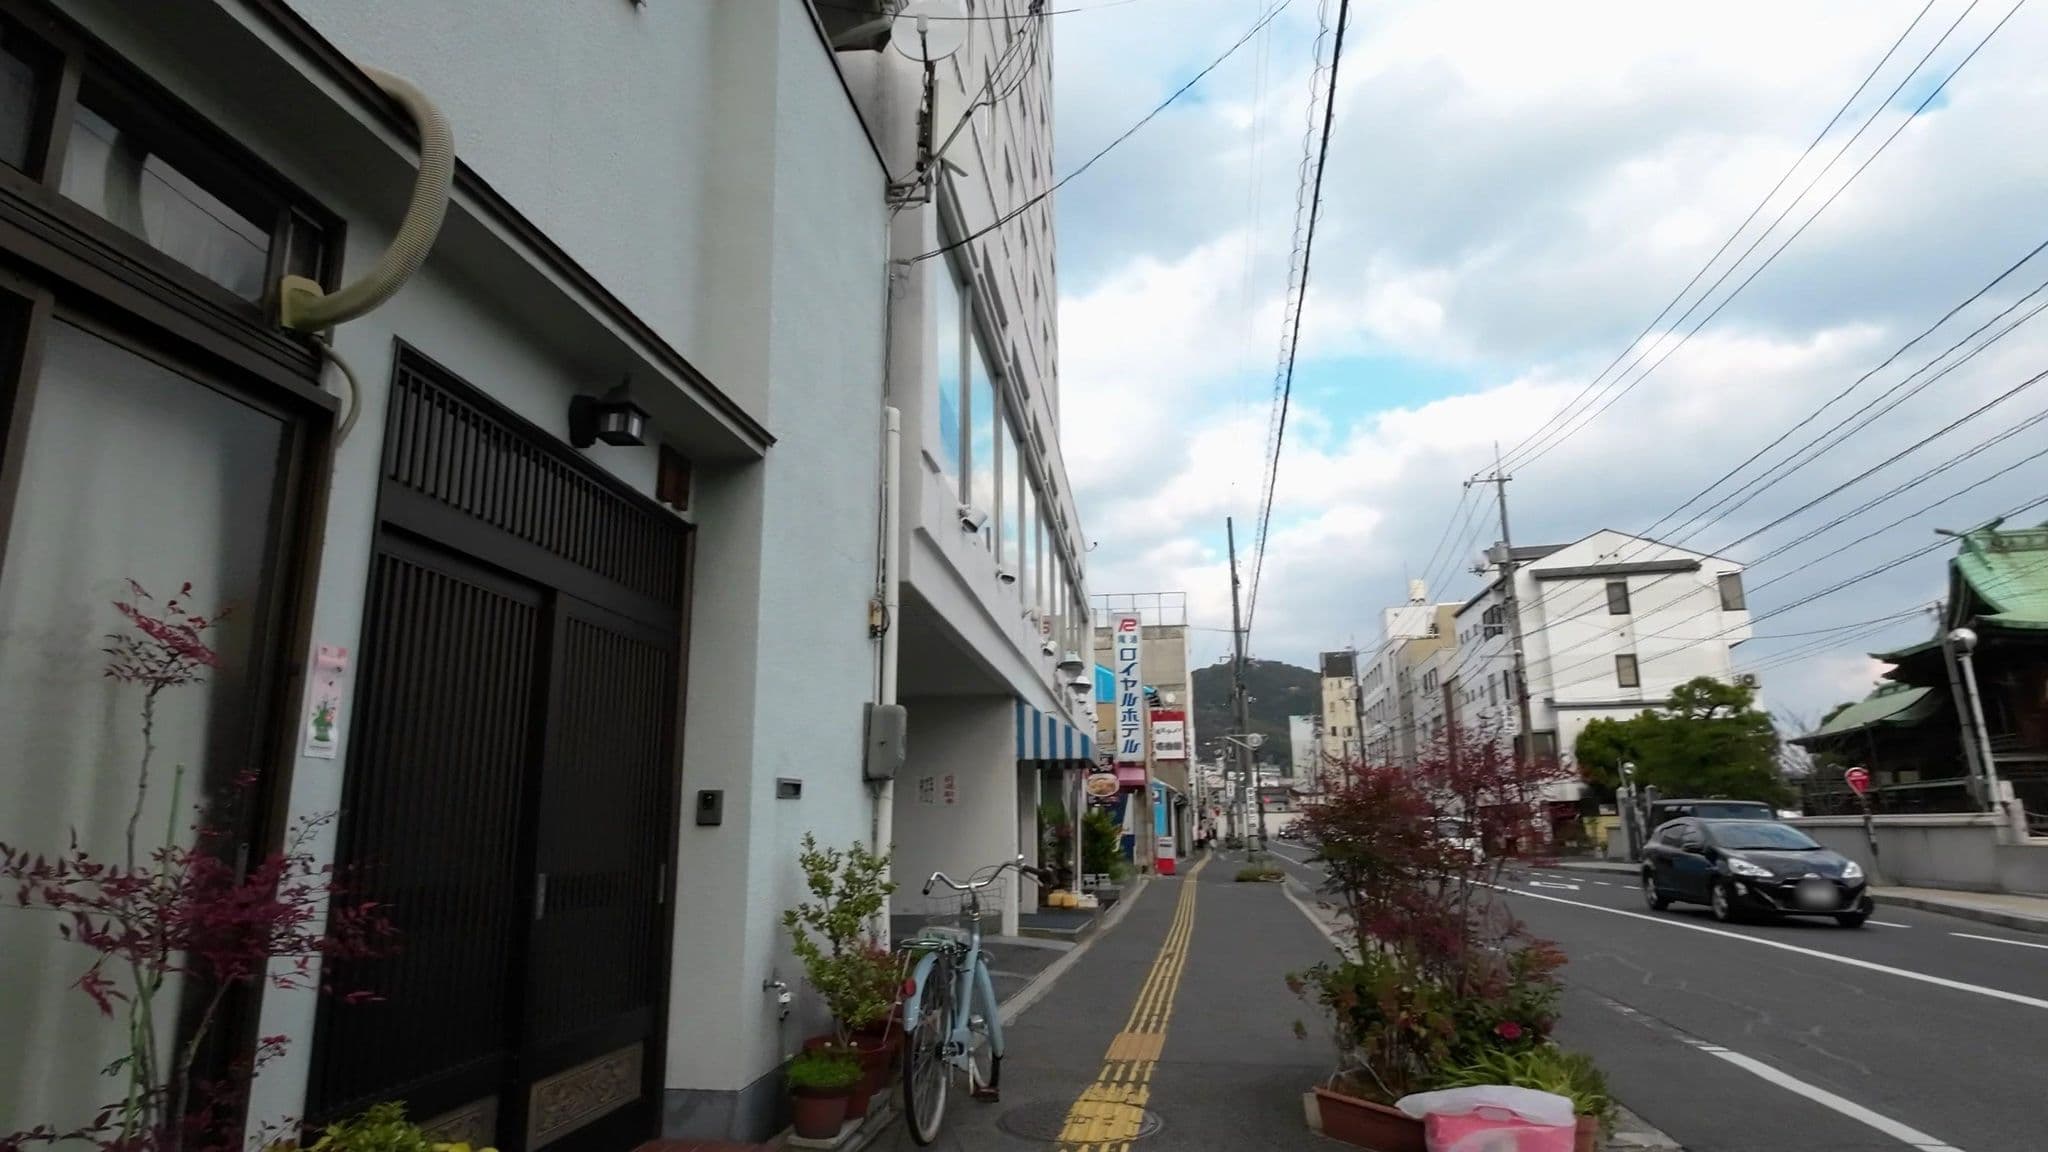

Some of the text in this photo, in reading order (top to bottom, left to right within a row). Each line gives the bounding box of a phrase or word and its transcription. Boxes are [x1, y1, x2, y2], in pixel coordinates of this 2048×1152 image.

[1119, 647, 1141, 754] ロイヤルホテル
